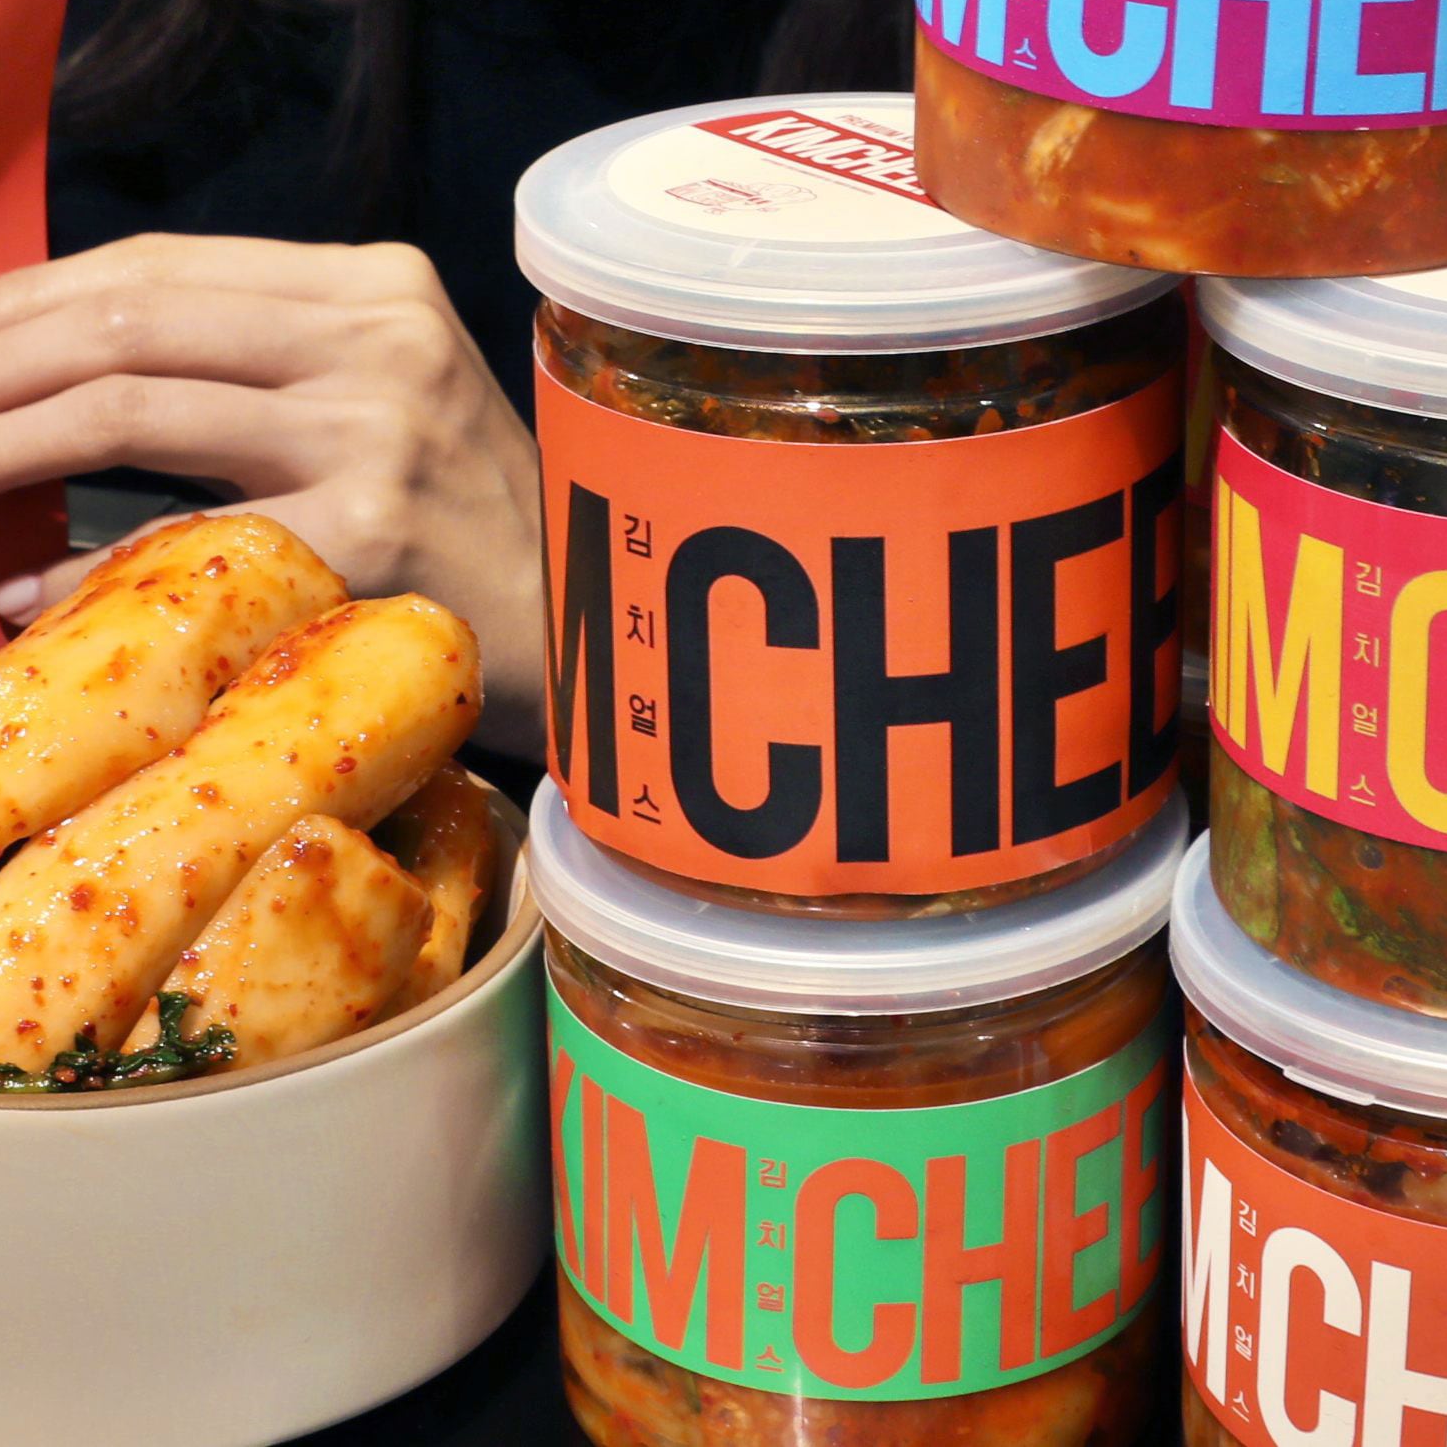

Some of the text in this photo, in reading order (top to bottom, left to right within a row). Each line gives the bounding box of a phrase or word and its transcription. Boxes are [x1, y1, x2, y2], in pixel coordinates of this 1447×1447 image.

[623, 513, 661, 827] 김치얼스
[1349, 561, 1383, 809] 김치얼스
[755, 1157, 788, 1374] 김치얼스
[1231, 1199, 1256, 1424] 김치얼스
